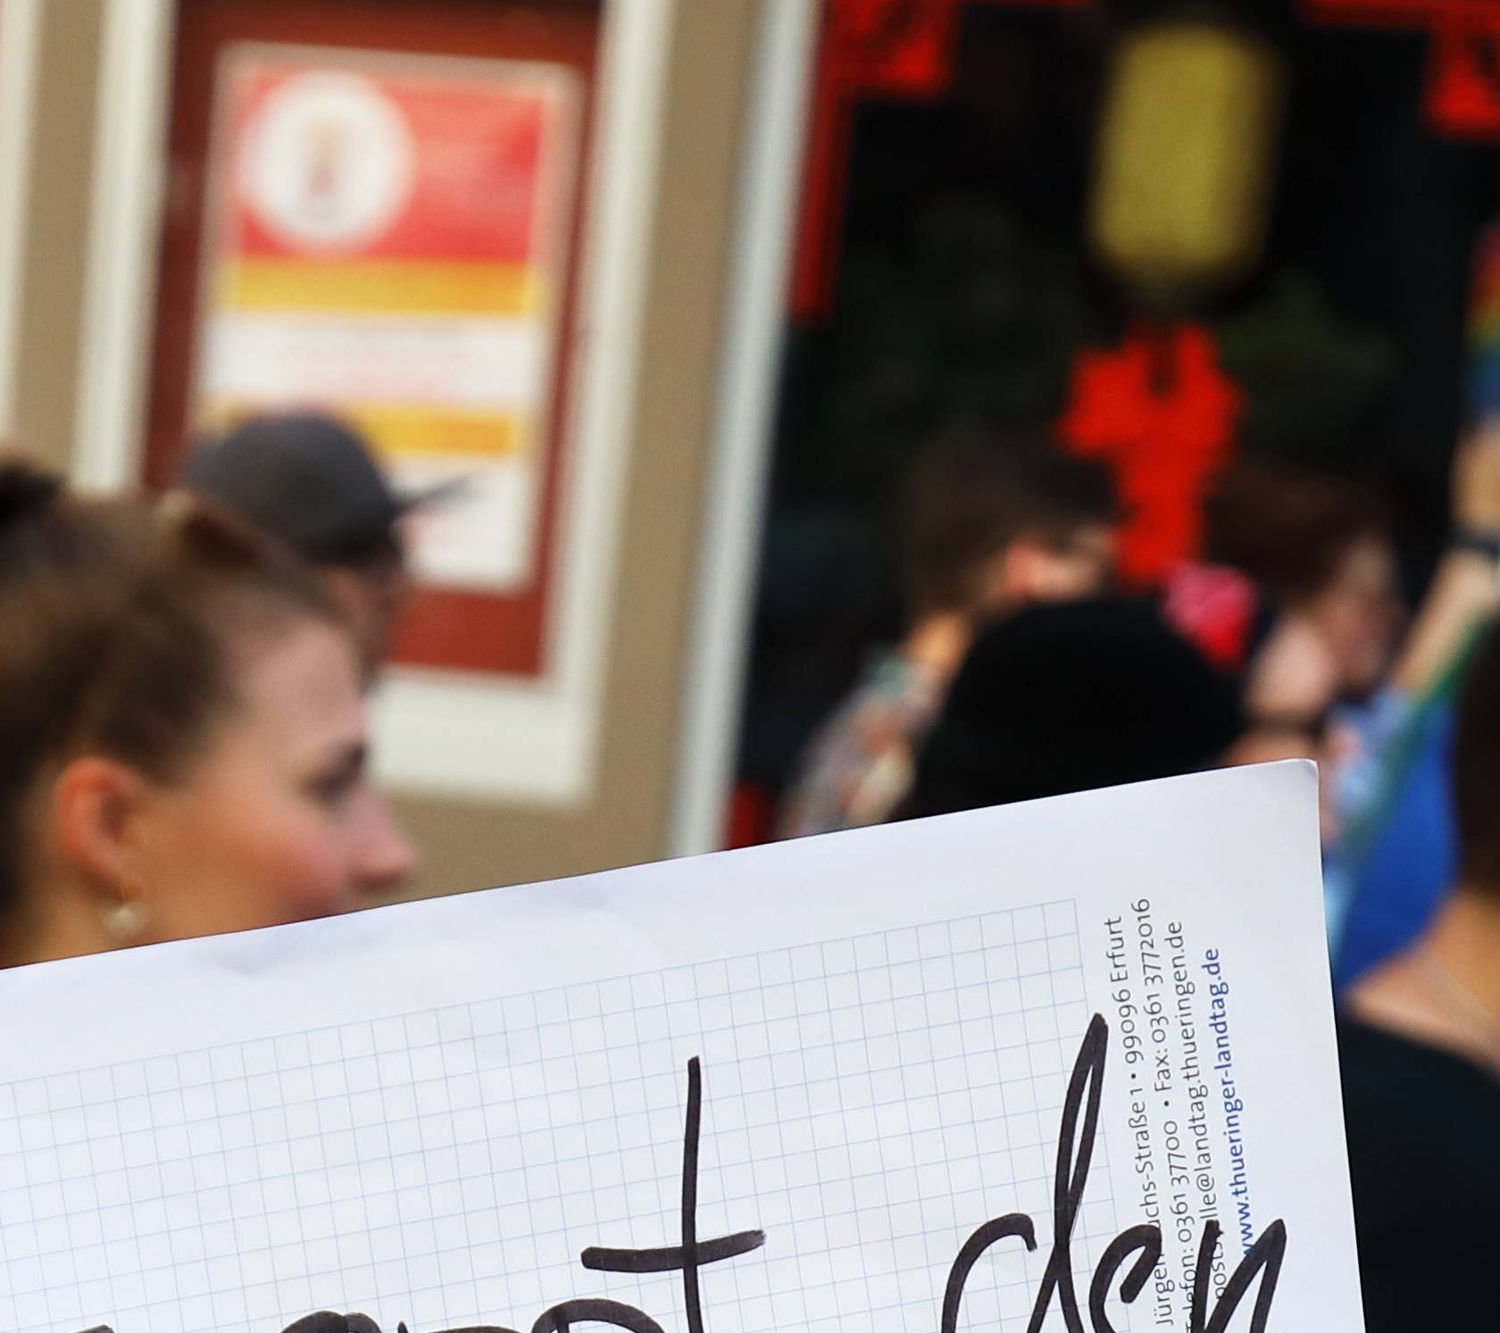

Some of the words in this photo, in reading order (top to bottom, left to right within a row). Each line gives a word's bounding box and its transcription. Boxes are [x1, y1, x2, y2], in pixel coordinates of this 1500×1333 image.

[1104, 915, 1129, 983] Erfurt
[1131, 898, 1164, 987] 3772016
[1112, 989, 1145, 1064] 99096
[1143, 993, 1170, 1043] 0361
[1130, 1087, 1144, 1096] 1
[1154, 1048, 1173, 1092] Fax:
[1164, 921, 1228, 1299] postlle@landtag.thueringen.de
[1163, 1120, 1190, 1187] 37700
[1128, 1101, 1175, 1325] Jürgenuchs-Straße
[1169, 1193, 1195, 1243] 0361
